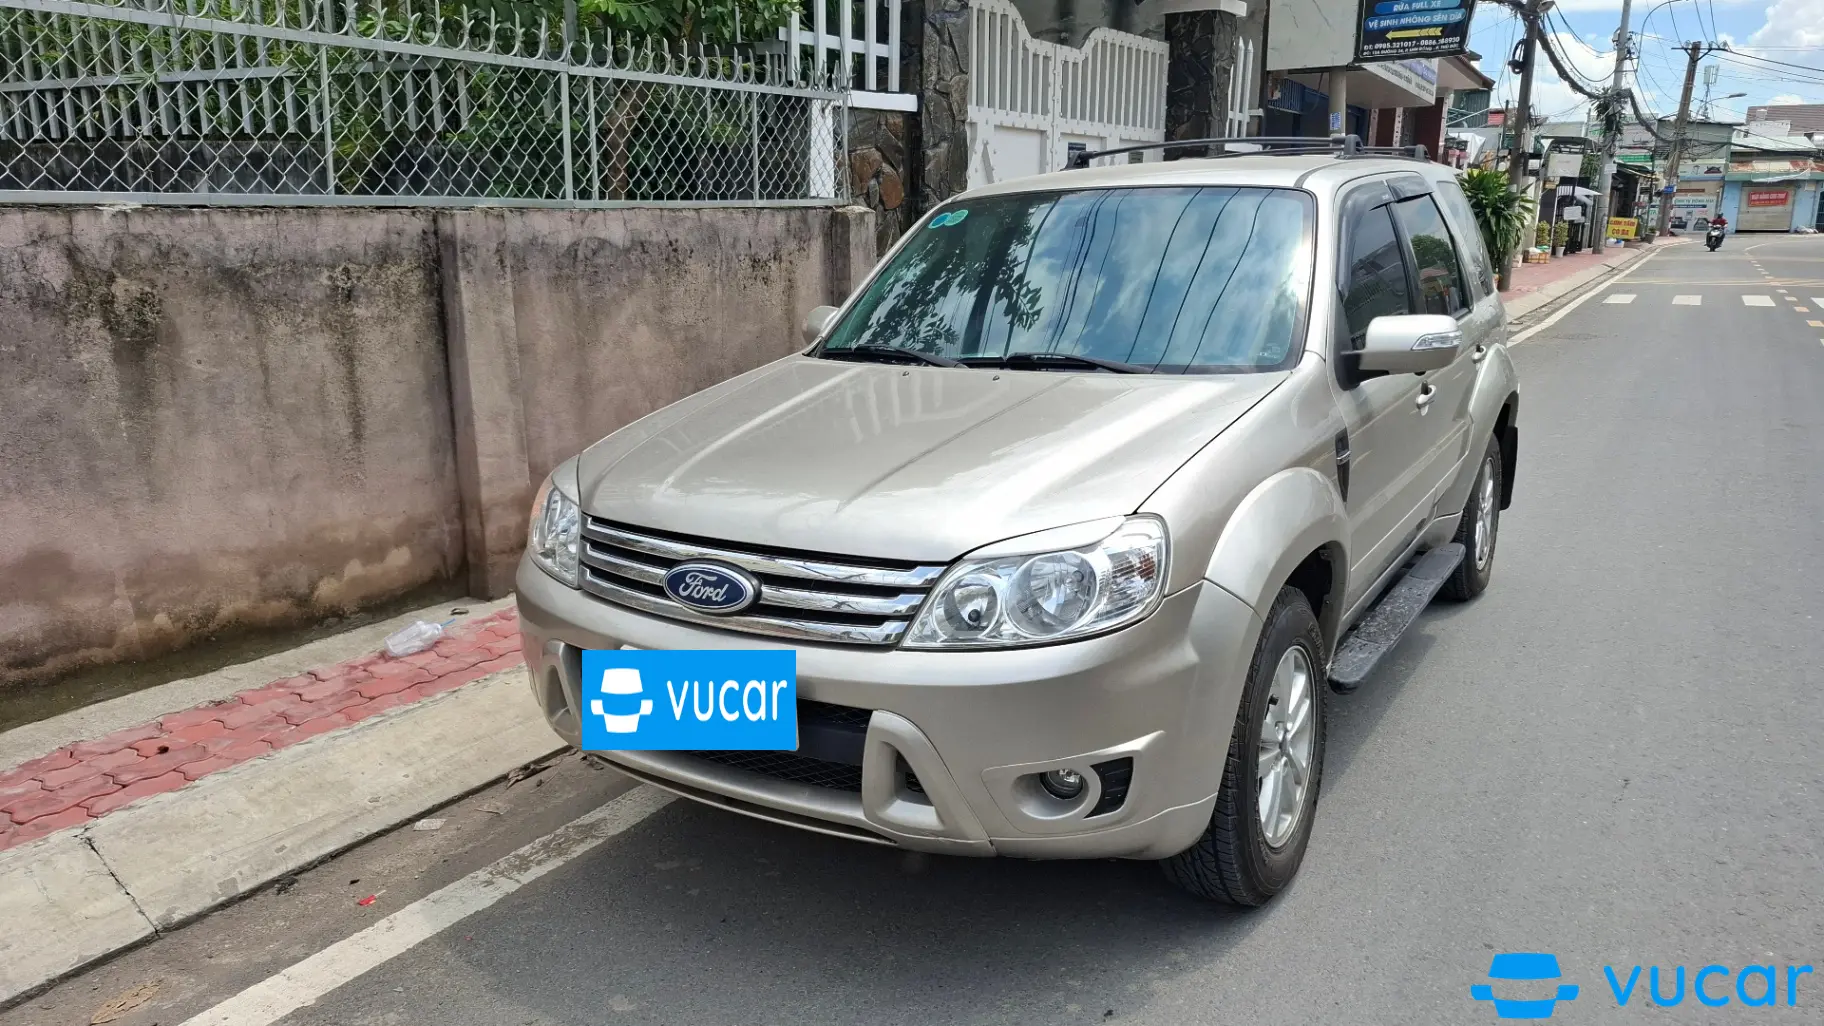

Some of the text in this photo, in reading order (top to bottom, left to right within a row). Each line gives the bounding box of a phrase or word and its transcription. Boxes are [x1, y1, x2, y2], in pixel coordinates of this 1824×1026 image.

[1393, 0, 1442, 12] RỬA FULL XE
[1368, 20, 1378, 30] VỆ
[1380, 18, 1398, 28] SINH
[1399, 14, 1431, 25] NHÔNG
[678, 571, 729, 603] Ford
